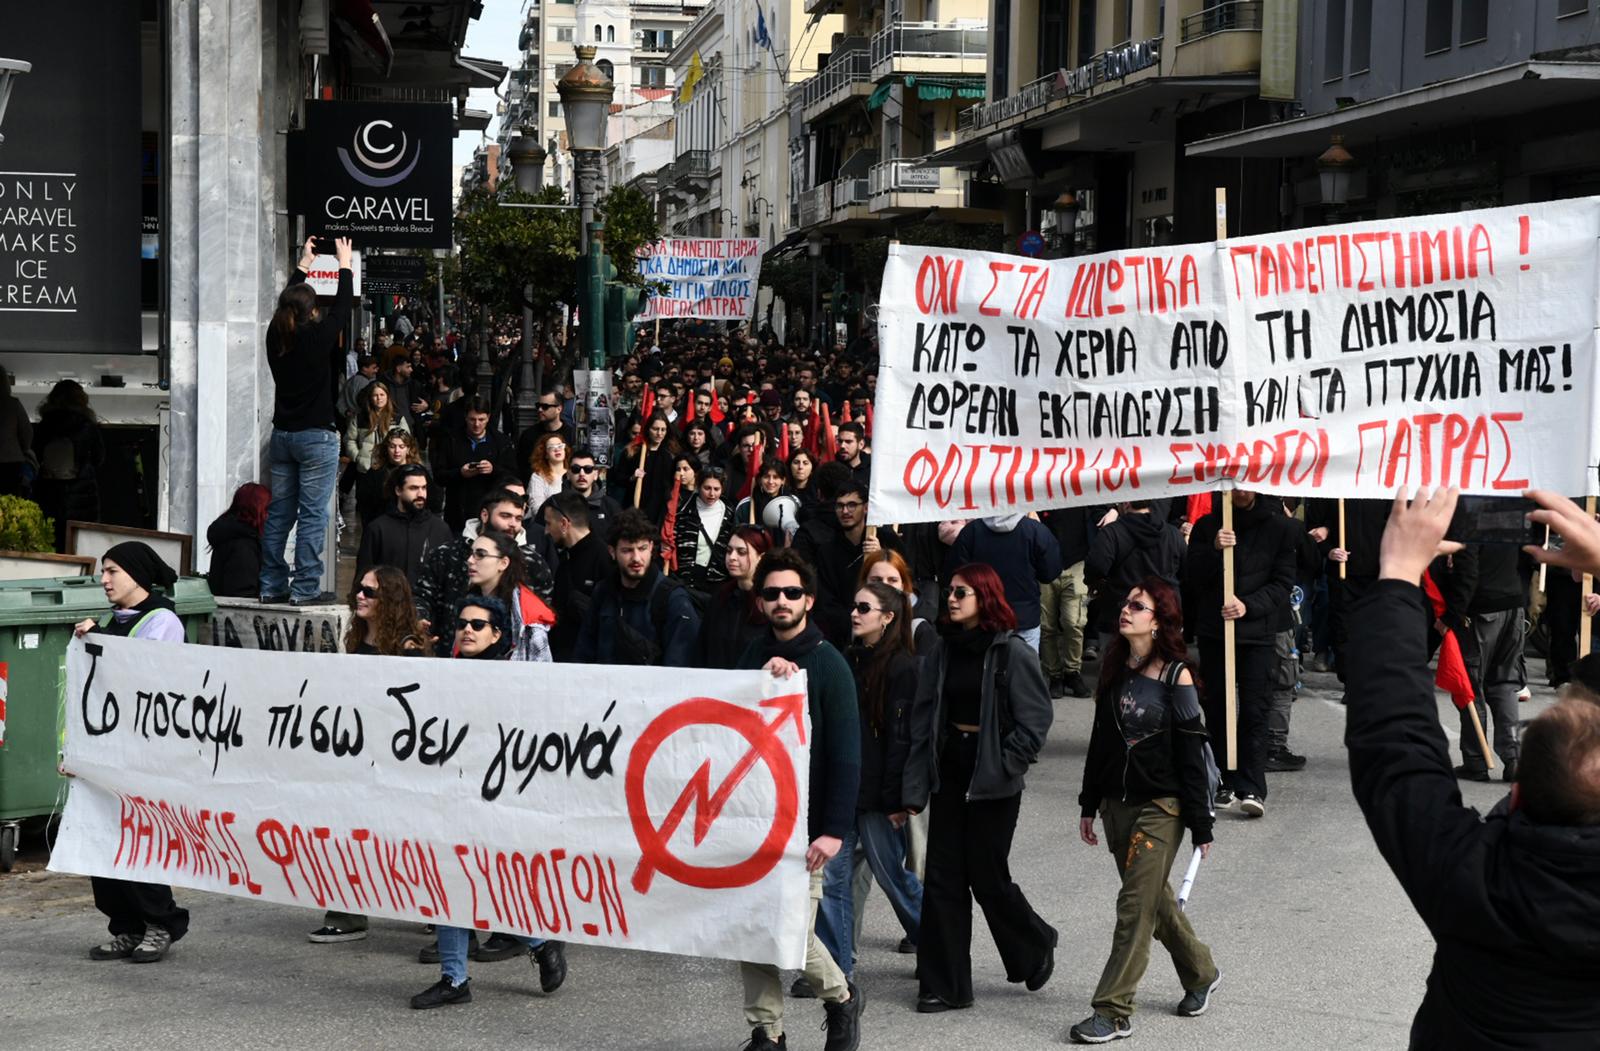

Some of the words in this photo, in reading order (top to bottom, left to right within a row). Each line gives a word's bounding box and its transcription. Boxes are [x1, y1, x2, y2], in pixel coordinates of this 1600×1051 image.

[0, 207, 77, 227] ARAVEL
[325, 195, 434, 222] CARAVEL
[325, 222, 349, 231] makes
[350, 222, 378, 232] Sweets
[385, 224, 410, 233] makes
[410, 224, 434, 233] Bread
[672, 239, 758, 258] ΠΑΝΕΠΙΣΤΗΜΙΑ
[16, 259, 47, 279] ICE
[307, 270, 355, 279] KIMB
[667, 257, 719, 276] ΔΗΜΟΣΙΑ
[0, 285, 77, 304] REAM
[687, 281, 705, 299] ΓΙΑ
[711, 279, 750, 297] ΟΛΟΥΣ
[915, 255, 964, 315] ΟΧΙ
[979, 261, 1049, 319] ΣΤΑ
[1065, 254, 1200, 319] ΙΔΙΩΤΙΚΑ
[697, 298, 746, 316] ΠΑΤΡΑΣ
[912, 322, 986, 372] ΚΑΤΩ
[1007, 325, 1041, 378] ΤΑ
[1055, 326, 1137, 379] ΧΕΡΙΑ
[1170, 320, 1228, 370] ΑΠΟ
[1255, 308, 1311, 364] ΤΗ
[1341, 289, 1496, 353] ΔΗΜΟΣΙΑ
[906, 380, 1019, 437] ΔΩΡΕΑΝ
[1039, 386, 1219, 440] ΕΚΠΑΙΔΕΥΣΗ
[1243, 375, 1289, 427] ΚΑΙ
[1310, 367, 1346, 413] ΤΑ
[1365, 350, 1481, 406] ΠΤΥΧΙΑ
[1499, 343, 1572, 394] ΜΑΣ!
[903, 442, 1142, 511] ΦΟΙΤΗΤΙΚΟΙ
[1168, 428, 1329, 487] ΣΥΛΛΟΓΟΙ
[1356, 411, 1529, 490] ΠΑΤΡΑΣ
[82, 643, 119, 736] Το
[134, 669, 243, 777] ποτάμι
[268, 679, 364, 757] πίσω
[387, 683, 469, 766] δεν
[481, 700, 622, 801] γυρνά
[256, 818, 450, 920] ΦΟΙΤΗΤΙΚΩΝ
[454, 840, 629, 938] ΣΥΛΛΟΓΩΝ
